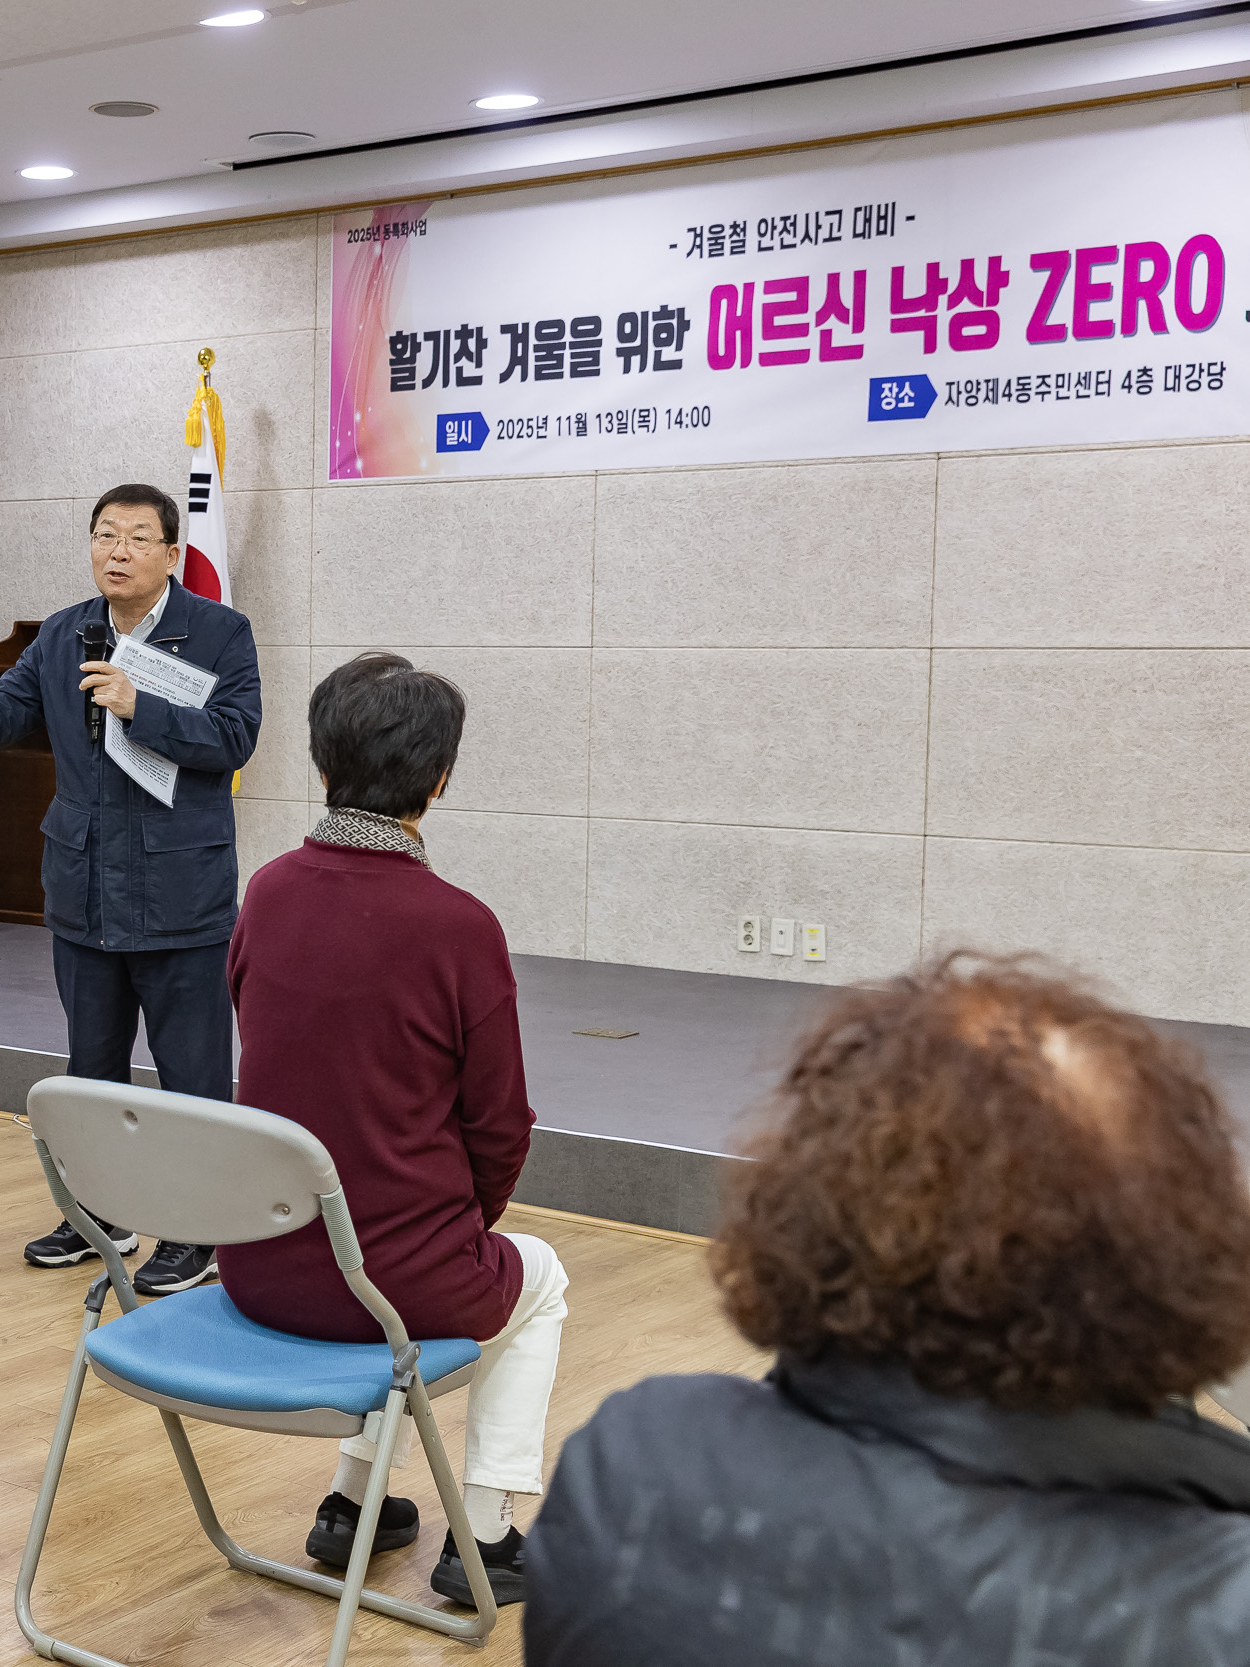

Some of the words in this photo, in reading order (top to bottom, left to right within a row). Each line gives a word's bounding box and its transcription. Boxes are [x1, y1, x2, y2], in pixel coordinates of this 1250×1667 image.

[347, 225, 381, 244] 2025년
[382, 218, 428, 241] 동특화사업
[686, 220, 748, 259] 겨울철
[756, 206, 843, 252] 안전사고
[851, 201, 897, 240] 대비
[388, 323, 488, 393] 활기찬
[498, 315, 603, 384] 겨울을
[615, 304, 691, 375] 위한
[706, 269, 867, 371] 어르신
[889, 254, 1010, 355] 낙상
[1025, 233, 1226, 346] ZERO
[880, 380, 915, 411] 장소
[944, 369, 1112, 408] 자양제4동주민센터
[1121, 366, 1154, 396] 4층
[1163, 361, 1227, 393] 대강당
[444, 420, 473, 446] 일시
[496, 415, 549, 441] 2025년
[555, 412, 588, 438] 11월
[595, 406, 658, 435] 13일(목)
[665, 405, 712, 430] 14:00
